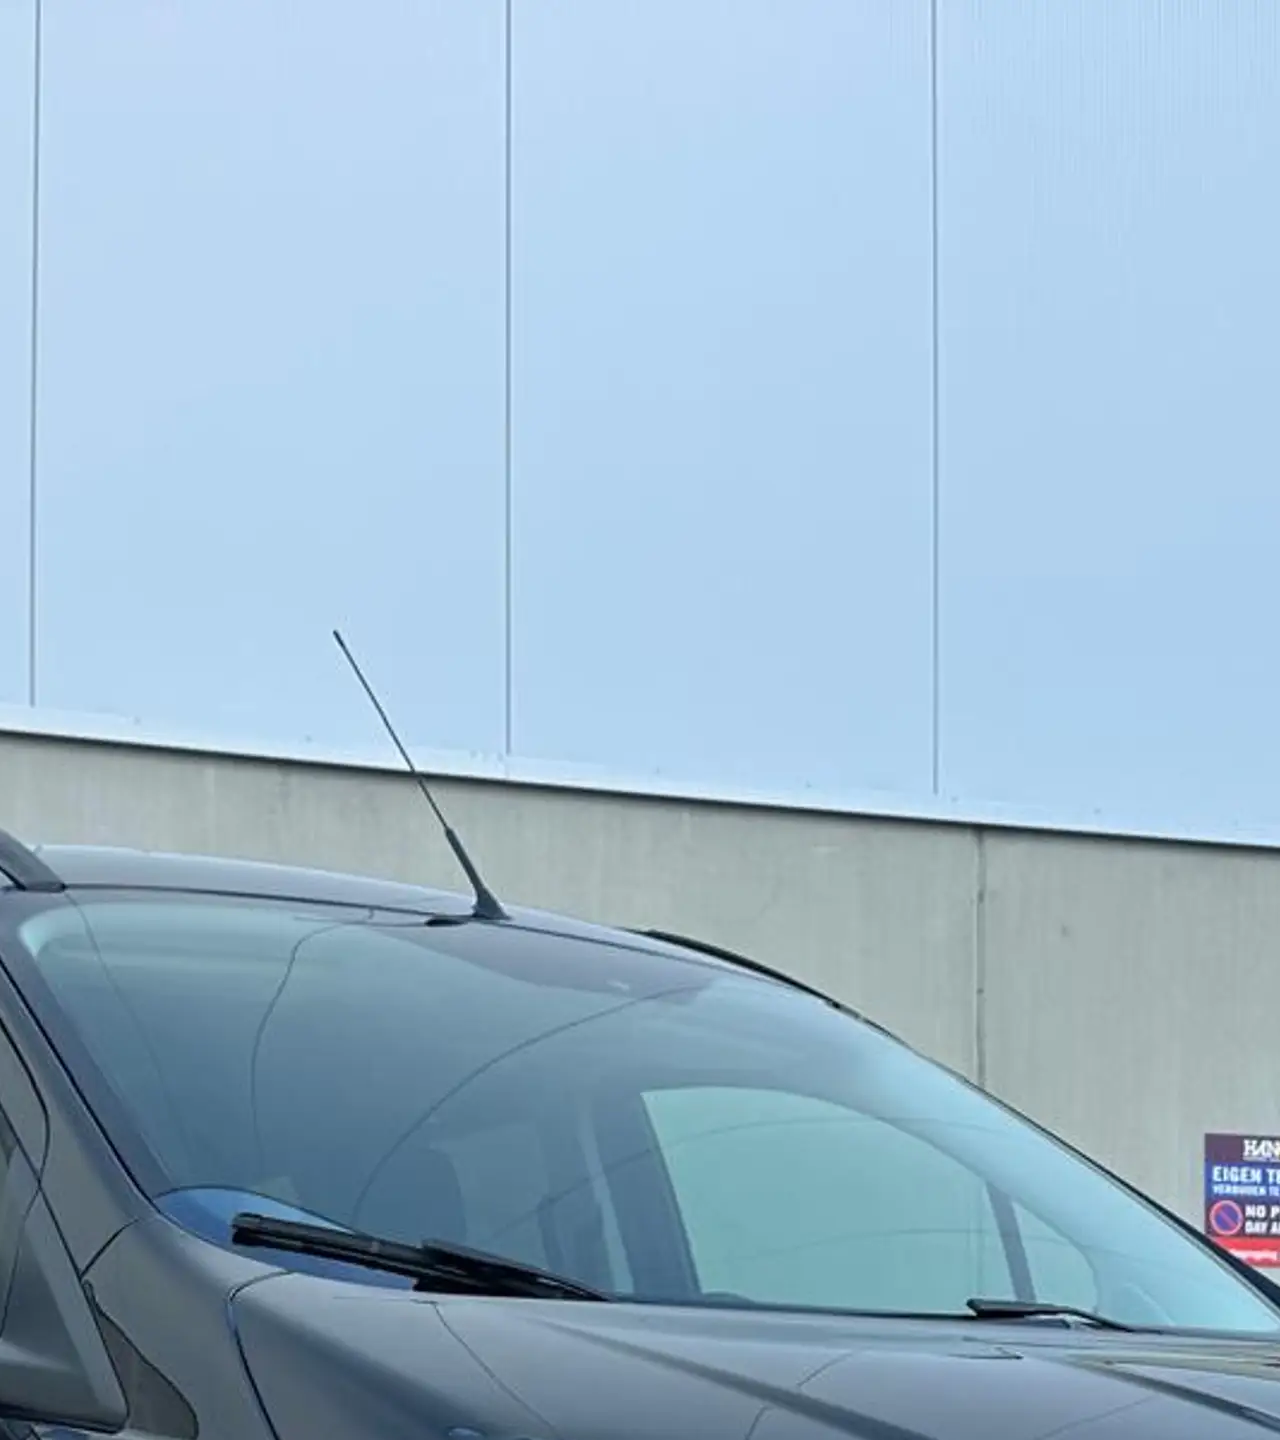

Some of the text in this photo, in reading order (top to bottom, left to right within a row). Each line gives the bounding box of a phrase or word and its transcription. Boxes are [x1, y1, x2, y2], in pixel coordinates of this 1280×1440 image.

[1212, 1166, 1262, 1183] EIGEN
[1245, 1205, 1266, 1218] NO
[1245, 1220, 1267, 1234] DAY
